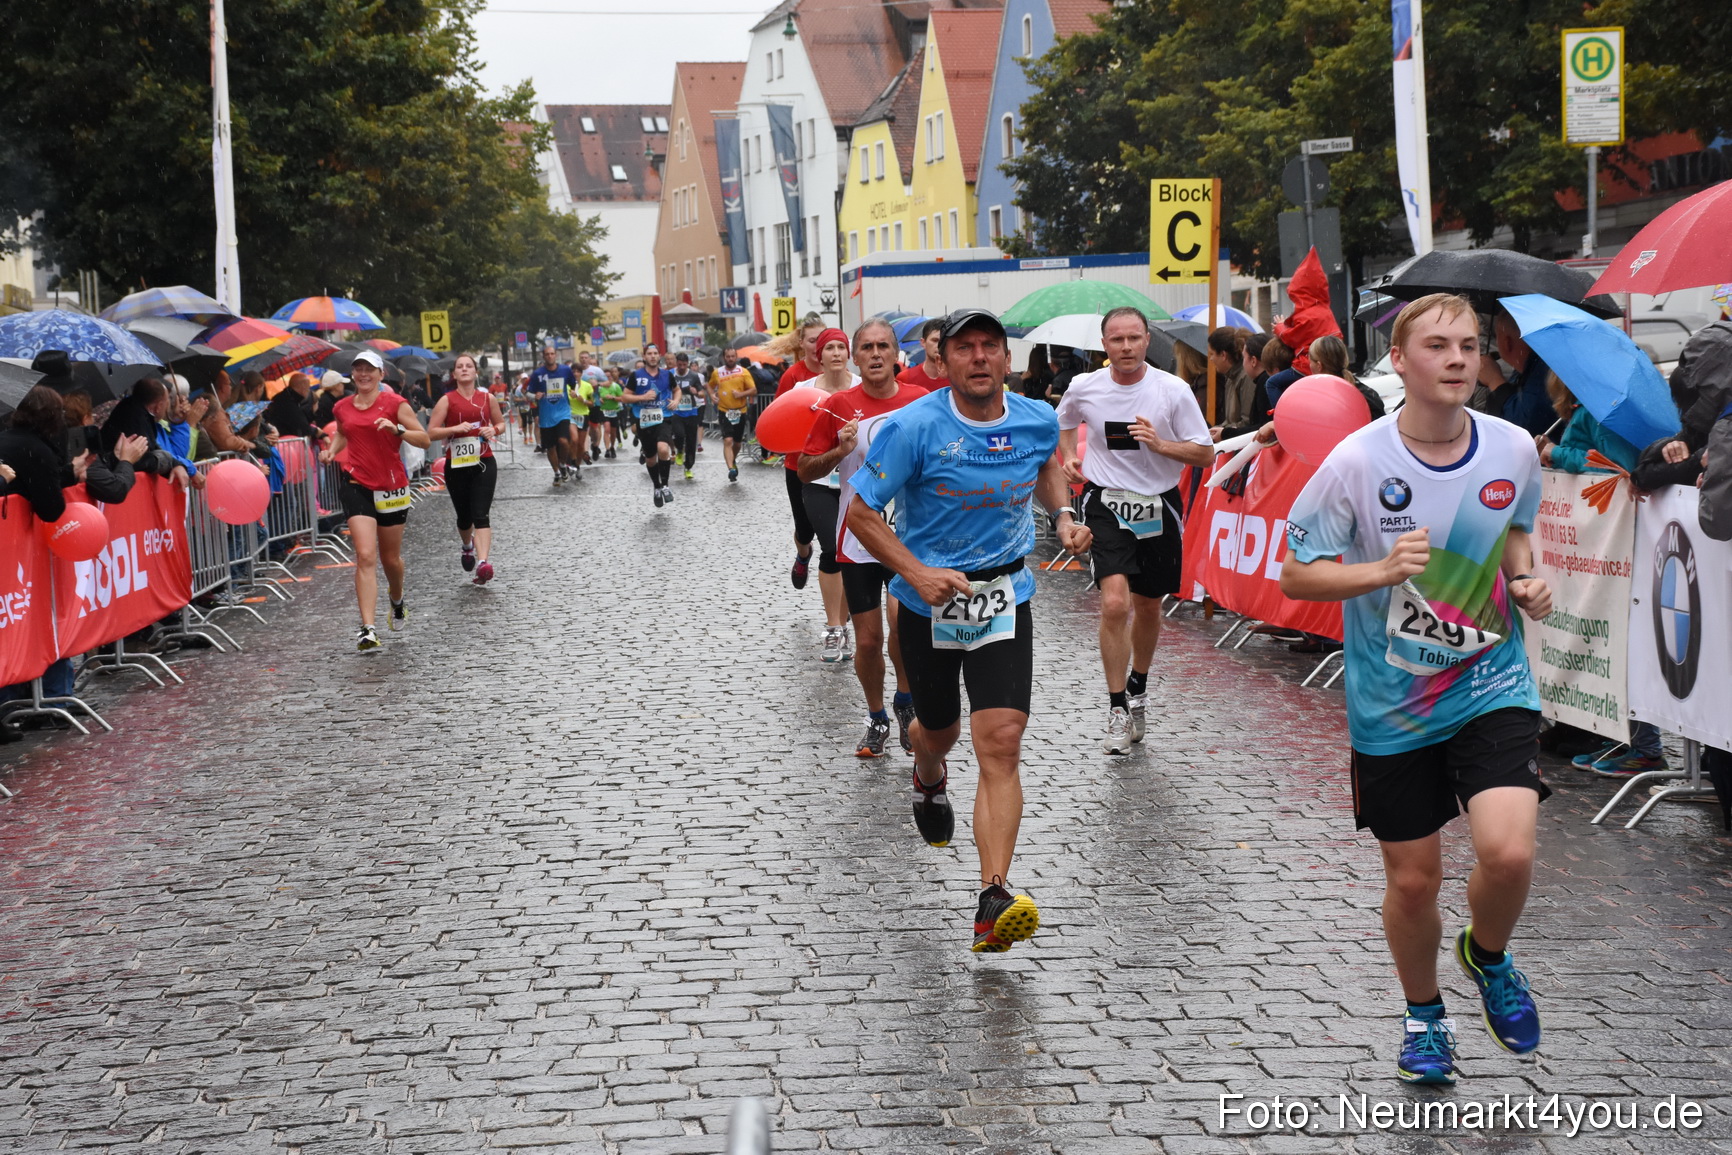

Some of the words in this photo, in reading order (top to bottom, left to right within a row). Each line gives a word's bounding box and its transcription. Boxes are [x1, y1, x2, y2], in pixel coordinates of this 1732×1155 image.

[1574, 85, 1611, 95] Marktplatz
[1310, 140, 1329, 151] Ulmer
[1330, 138, 1350, 149] Gasse
[1159, 184, 1212, 202] Block
[870, 201, 887, 221] HOTEL
[1167, 210, 1202, 262] C
[774, 298, 794, 307] Block
[424, 313, 445, 321] Block
[777, 310, 790, 329] D
[429, 324, 443, 343] D
[636, 377, 649, 386] 13
[642, 413, 661, 422] 2148
[455, 443, 475, 457] 230
[935, 482, 995, 497] Gesunde
[1485, 487, 1513, 502] Hervis
[1538, 496, 1573, 519] ervice-Line:
[1380, 515, 1416, 527] PARTL
[1380, 525, 1416, 534] Neumarkt
[941, 589, 1008, 622] 2723
[1471, 659, 1497, 679] 17.
